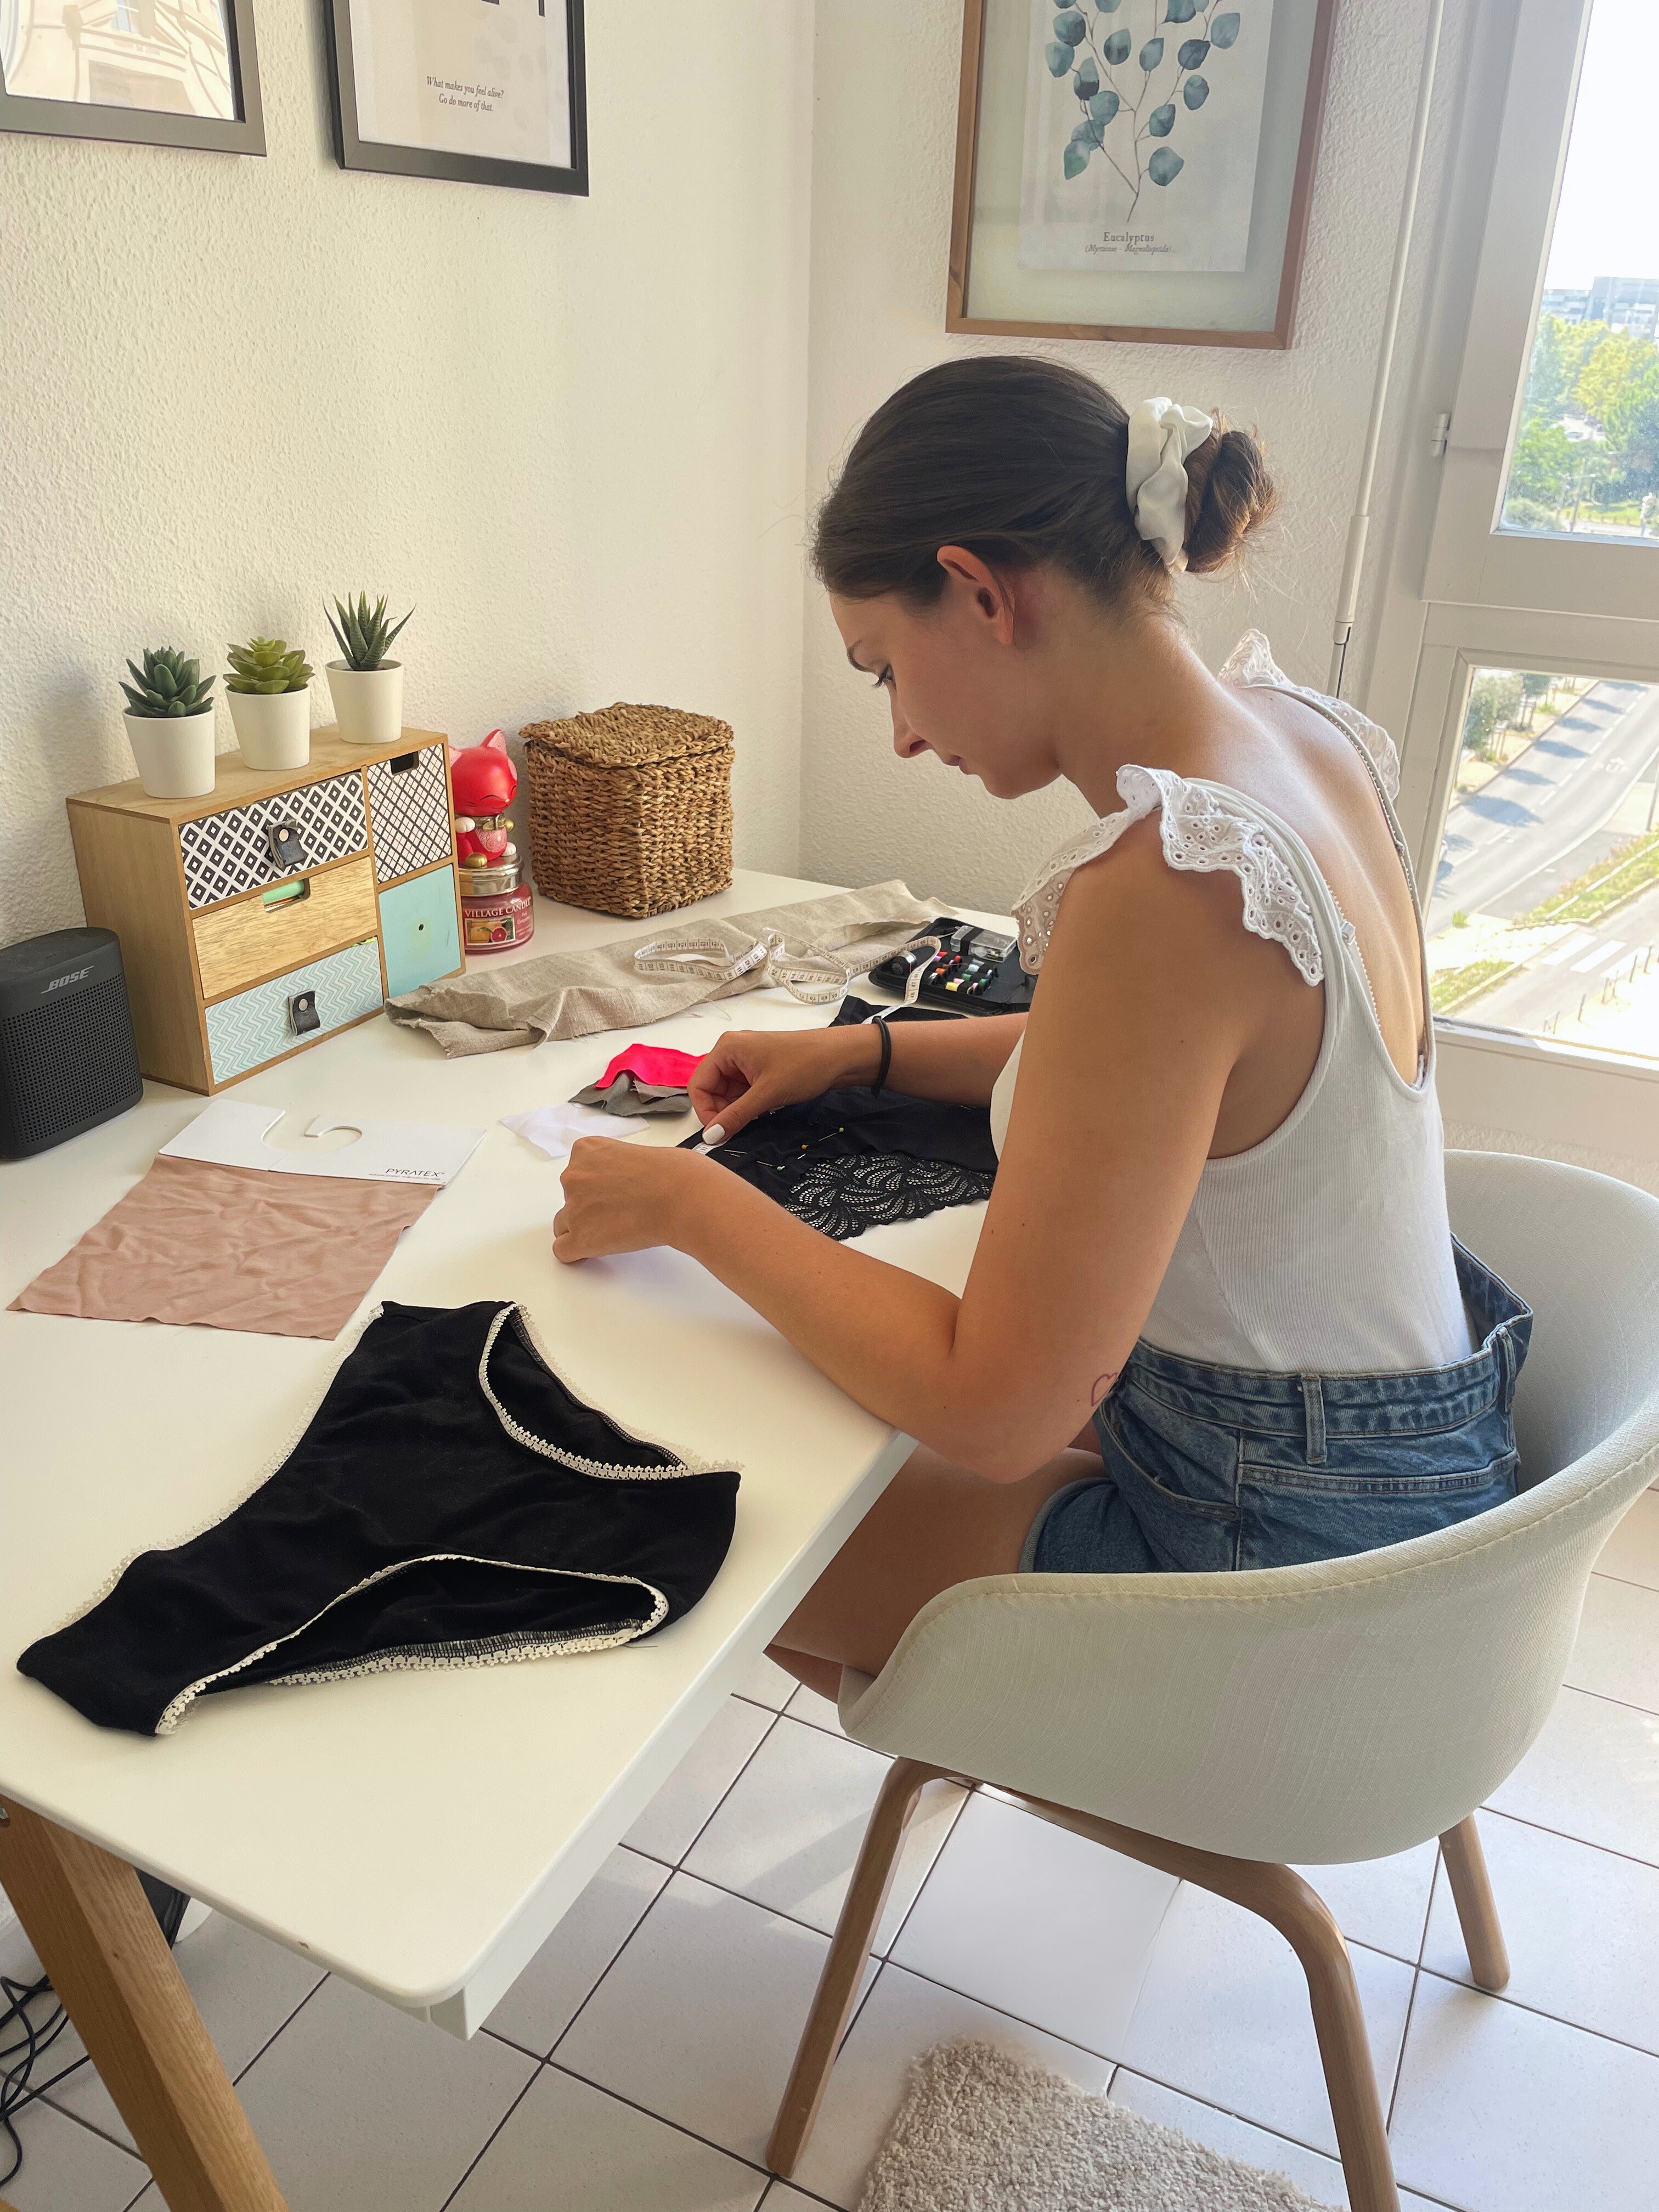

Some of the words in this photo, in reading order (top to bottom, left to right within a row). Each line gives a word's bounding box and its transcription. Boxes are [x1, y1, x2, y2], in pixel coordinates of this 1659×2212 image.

[427, 76, 443, 88] What
[445, 80, 463, 91] makes
[464, 86, 475, 95] you
[475, 84, 487, 97] feel
[487, 87, 504, 98] alive?
[439, 93, 448, 104] Go
[449, 95, 456, 105] do
[458, 100, 472, 108] more
[473, 100, 481, 112] of
[1103, 232, 1154, 245] Eucalyptus
[465, 909, 504, 917] VILLAGE
[506, 896, 531, 913] CANDLE
[41, 966, 94, 994] BOSE
